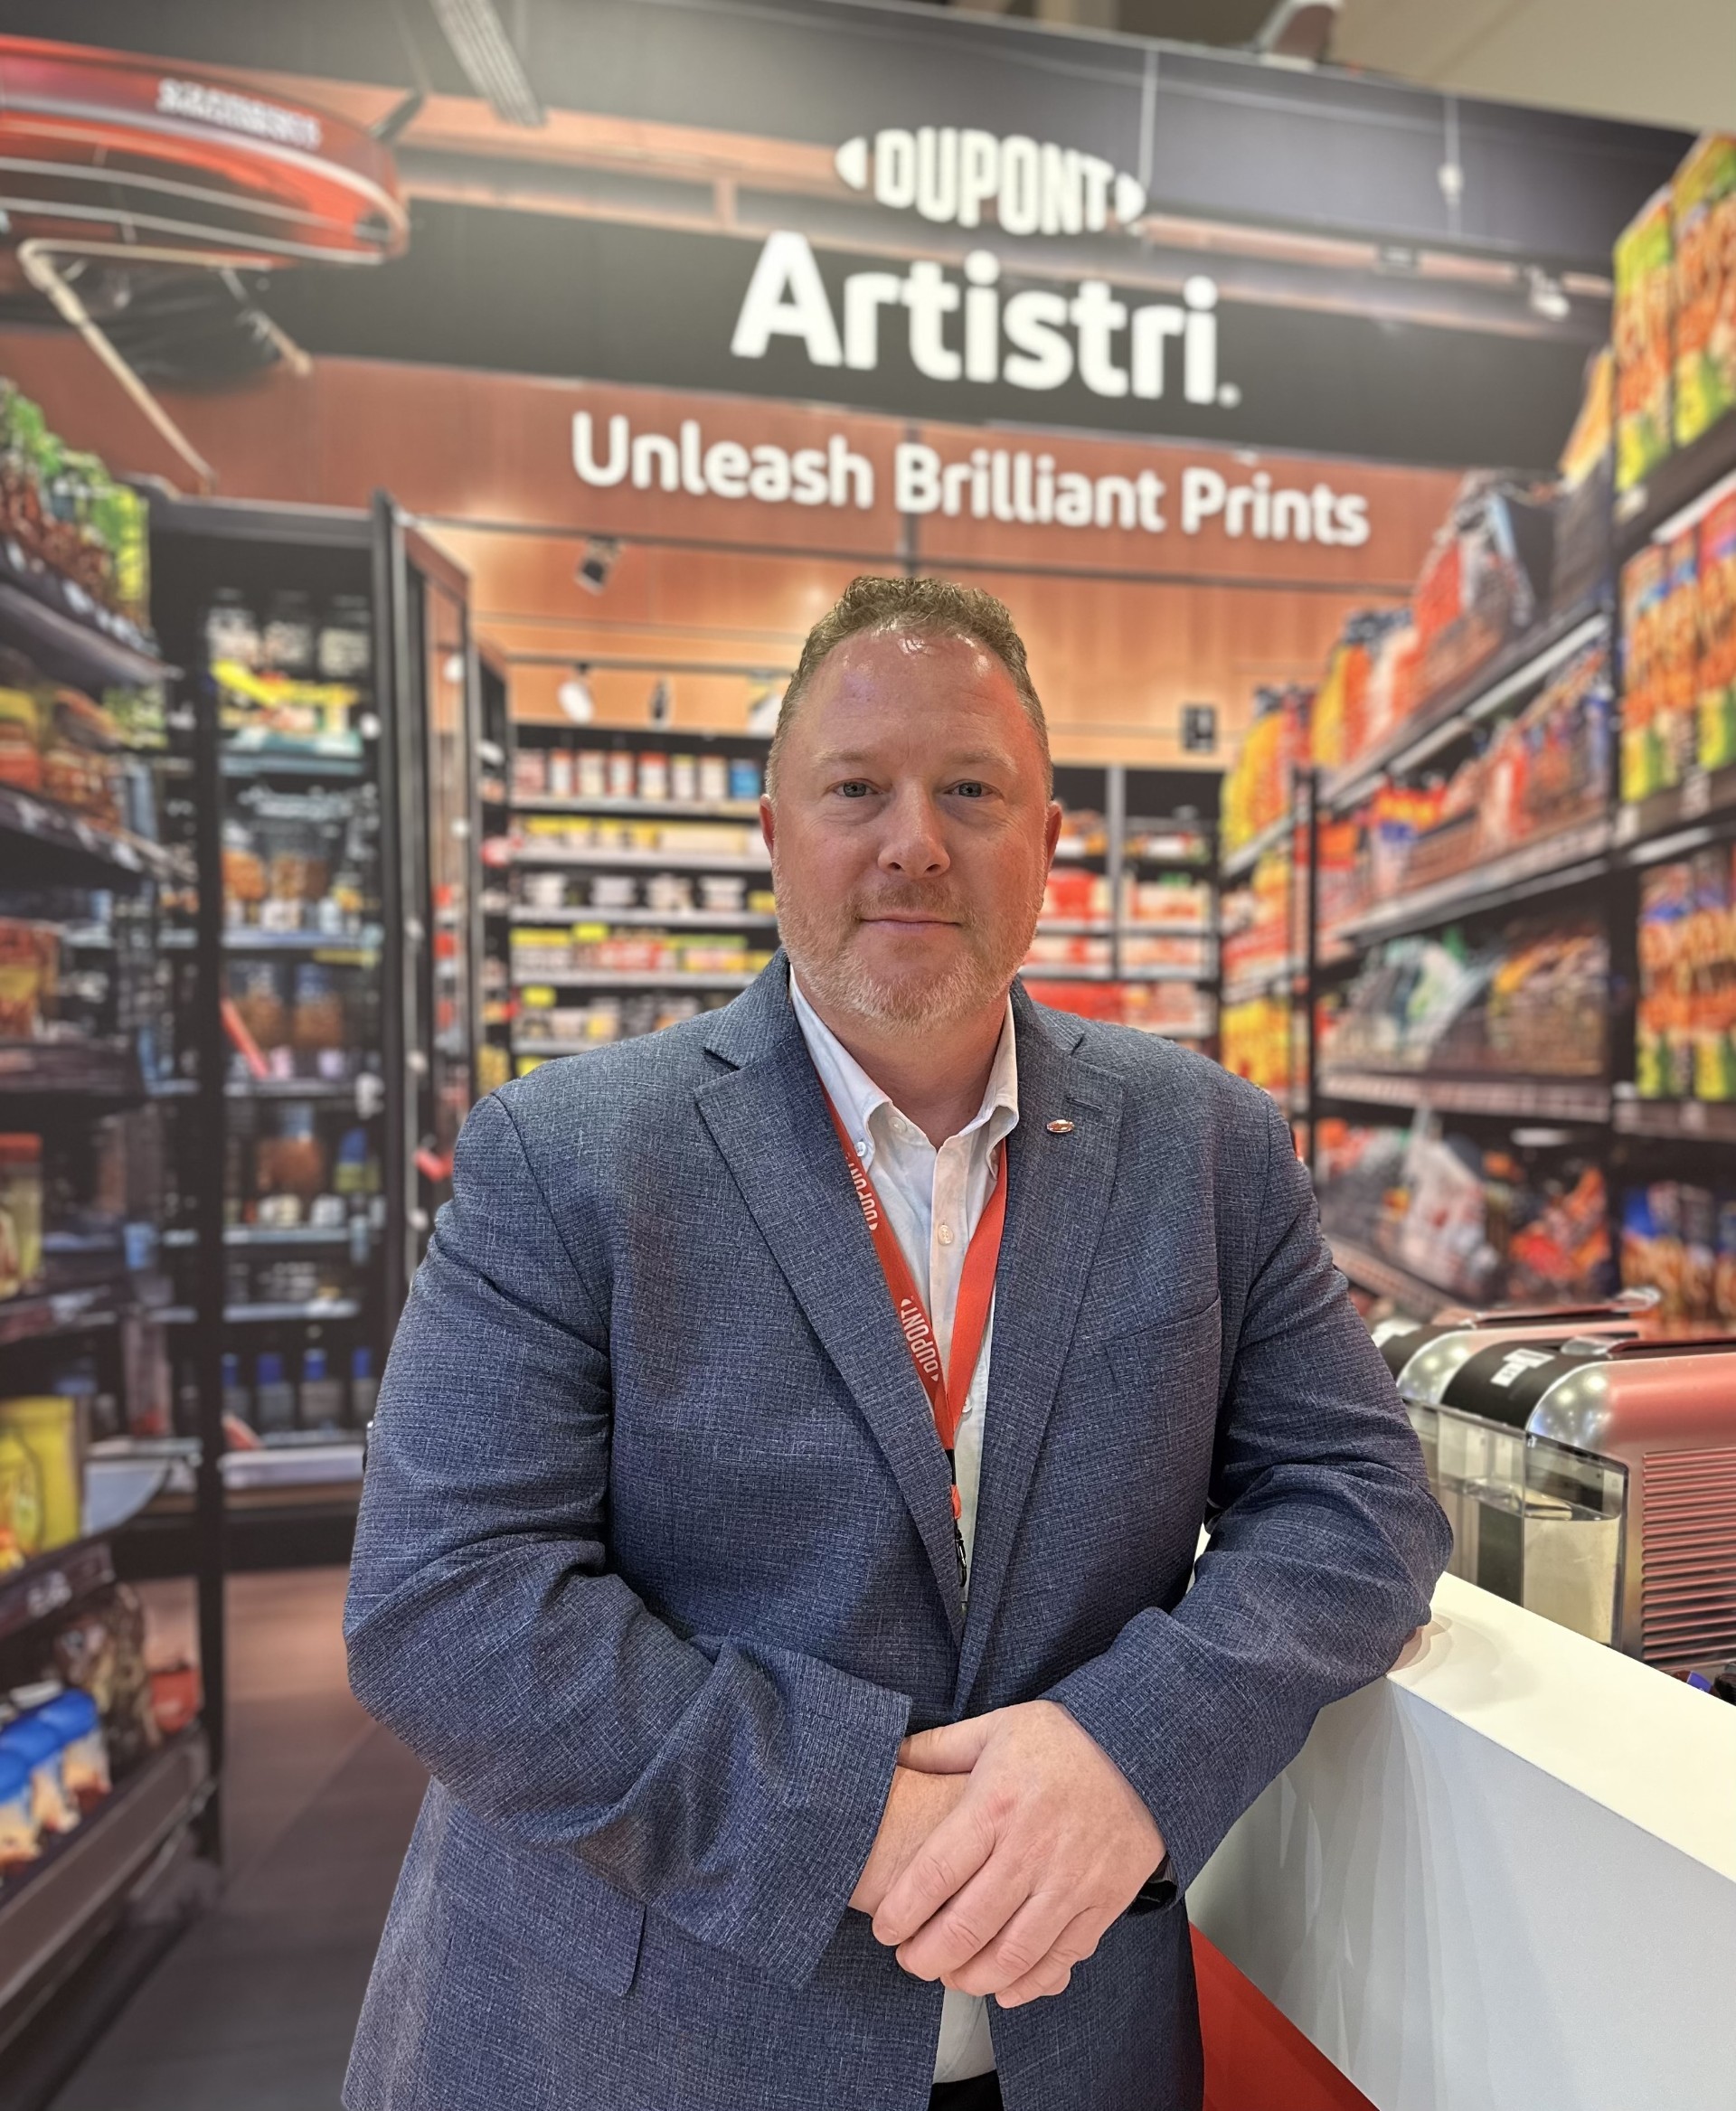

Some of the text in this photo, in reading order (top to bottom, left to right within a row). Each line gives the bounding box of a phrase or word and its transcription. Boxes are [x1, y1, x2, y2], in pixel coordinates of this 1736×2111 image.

[873, 126, 1116, 236] DUPONT
[571, 410, 1372, 547] Unleash Brilliant Prints
[901, 1306, 939, 1373] DUPONT
